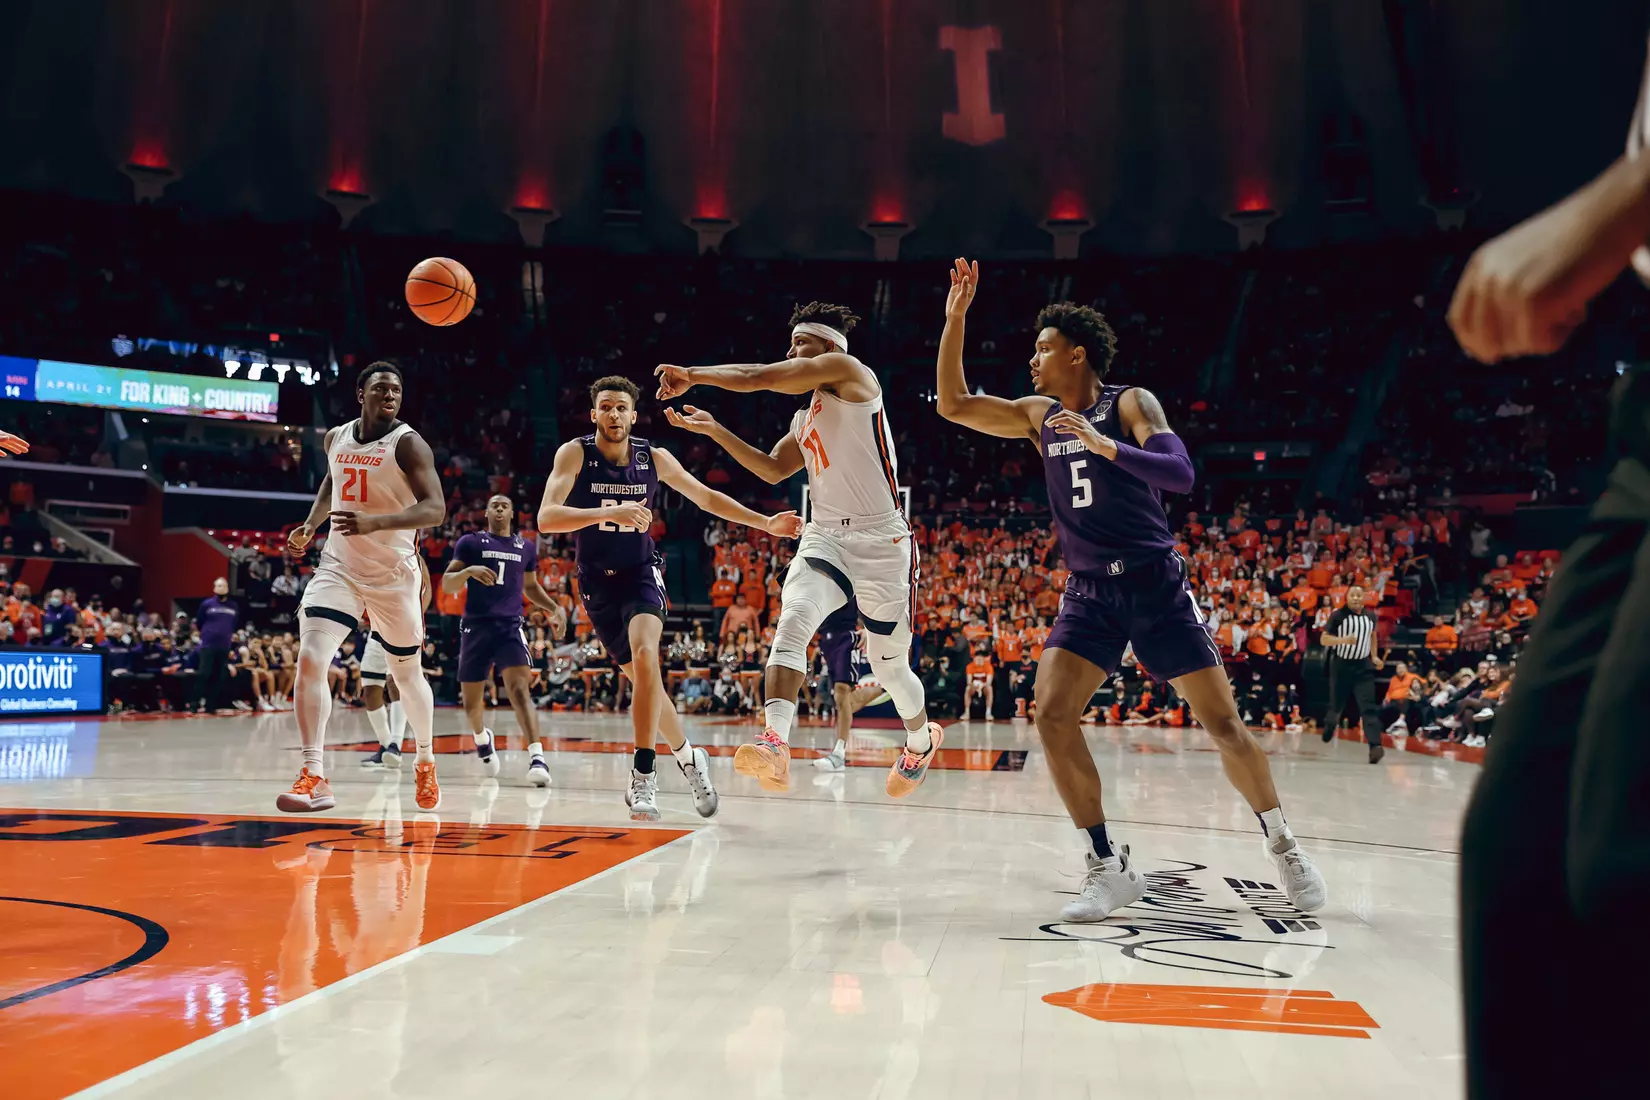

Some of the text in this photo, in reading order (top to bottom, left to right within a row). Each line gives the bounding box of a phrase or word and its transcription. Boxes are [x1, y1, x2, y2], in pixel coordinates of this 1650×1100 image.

[5, 385, 20, 397] 14
[46, 380, 89, 393] APRIL
[120, 380, 150, 403] FOR
[152, 384, 190, 406] KING
[204, 388, 272, 414] COUNTRY
[803, 427, 830, 478] 11
[1047, 439, 1088, 458] NORTHWES
[335, 453, 383, 467] ILLINOIS
[341, 467, 368, 503] 21
[590, 482, 648, 495] NORTHWESTERN
[1069, 459, 1093, 509] 5
[495, 560, 506, 586] 1
